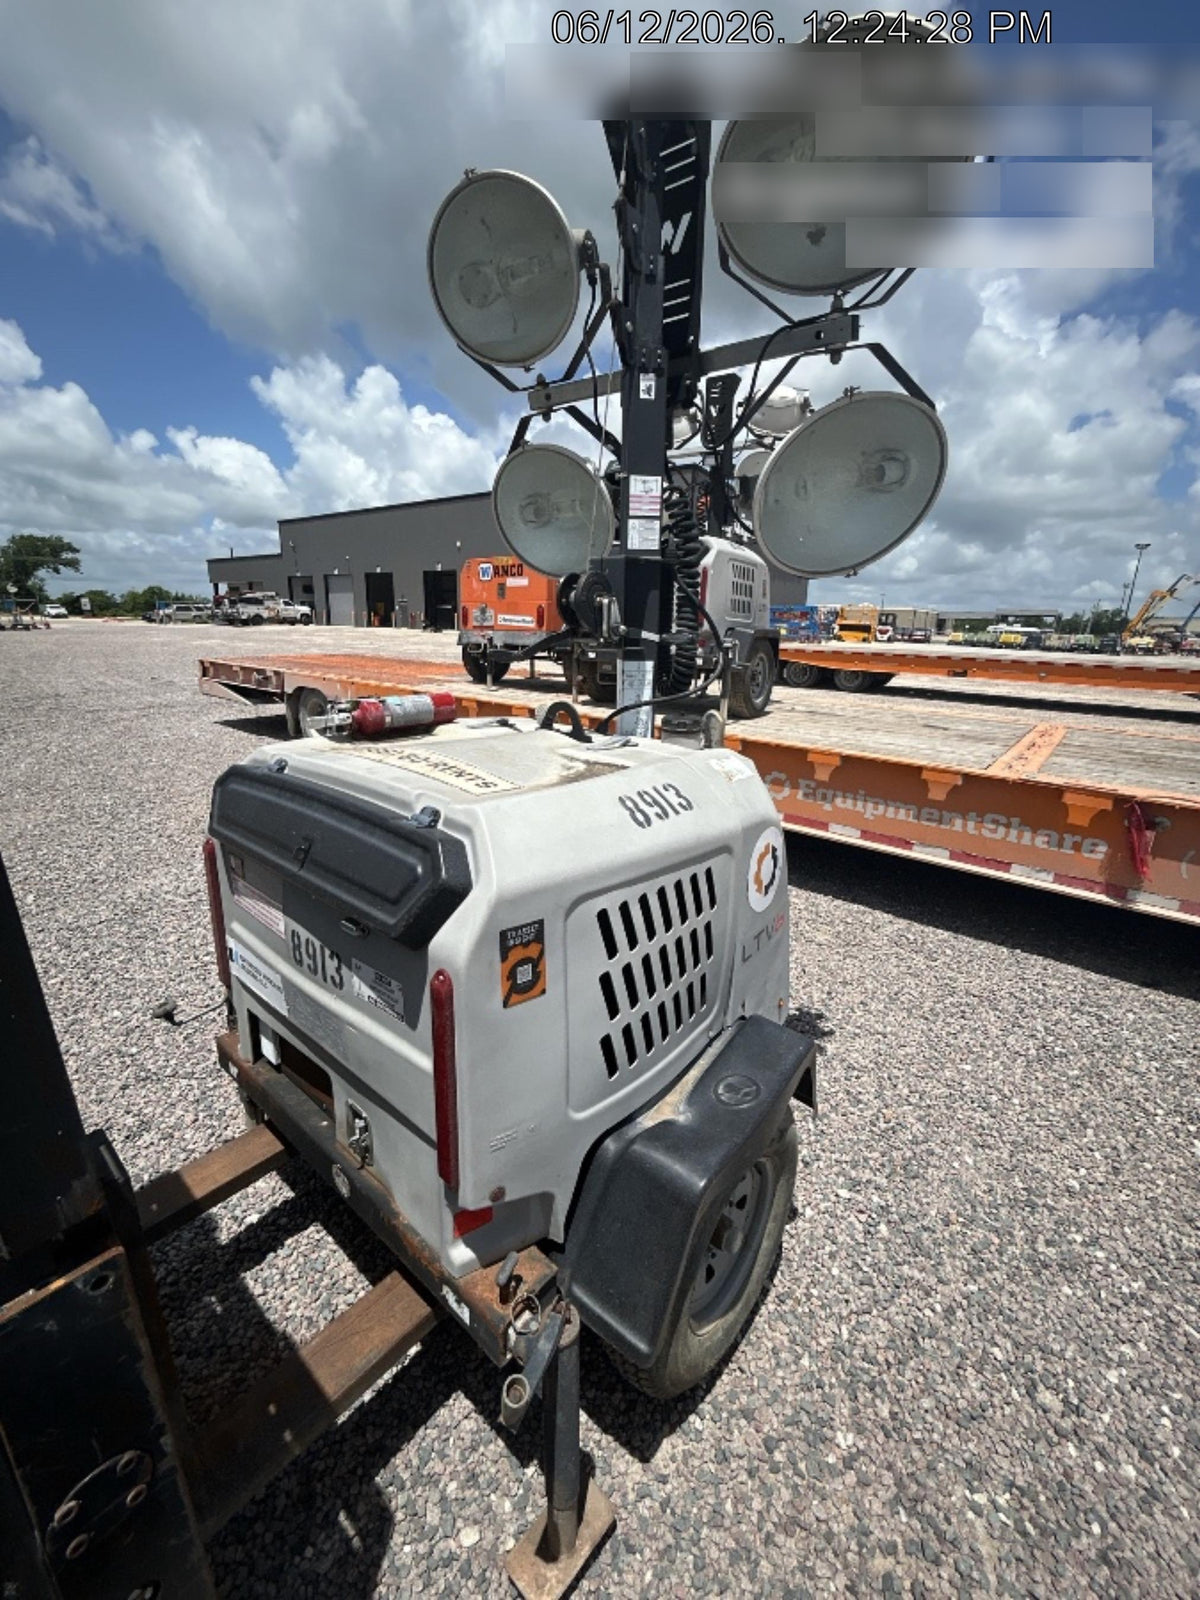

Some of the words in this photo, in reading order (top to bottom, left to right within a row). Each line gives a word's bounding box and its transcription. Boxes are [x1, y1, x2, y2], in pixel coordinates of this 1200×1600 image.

[478, 562, 524, 581] WANCO
[617, 782, 695, 829] 8913
[797, 777, 1110, 861] EquipmentShare
[290, 929, 345, 991] 8913
